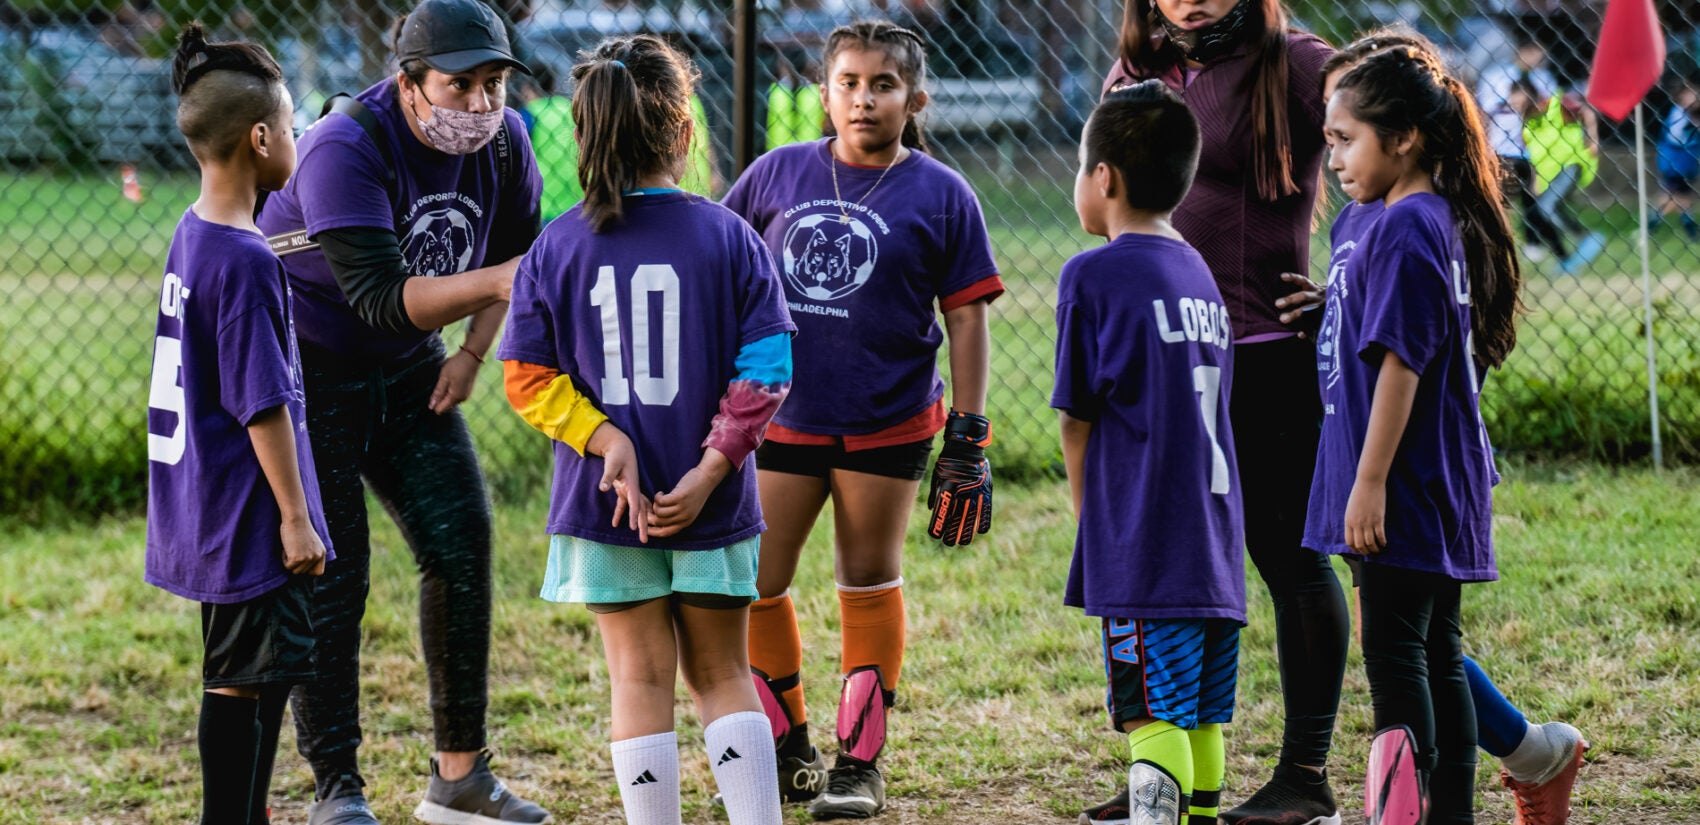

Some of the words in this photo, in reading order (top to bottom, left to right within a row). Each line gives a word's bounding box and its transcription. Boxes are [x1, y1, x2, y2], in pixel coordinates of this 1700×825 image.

[458, 193, 484, 219] LOBOS
[784, 201, 811, 218] CLUB
[867, 209, 891, 235] LOBOS
[787, 301, 849, 318] PHILADELPHIA
[1153, 297, 1230, 350] LOBOS
[590, 264, 680, 406] 10
[147, 335, 186, 466] 5
[933, 490, 952, 536] reusch
